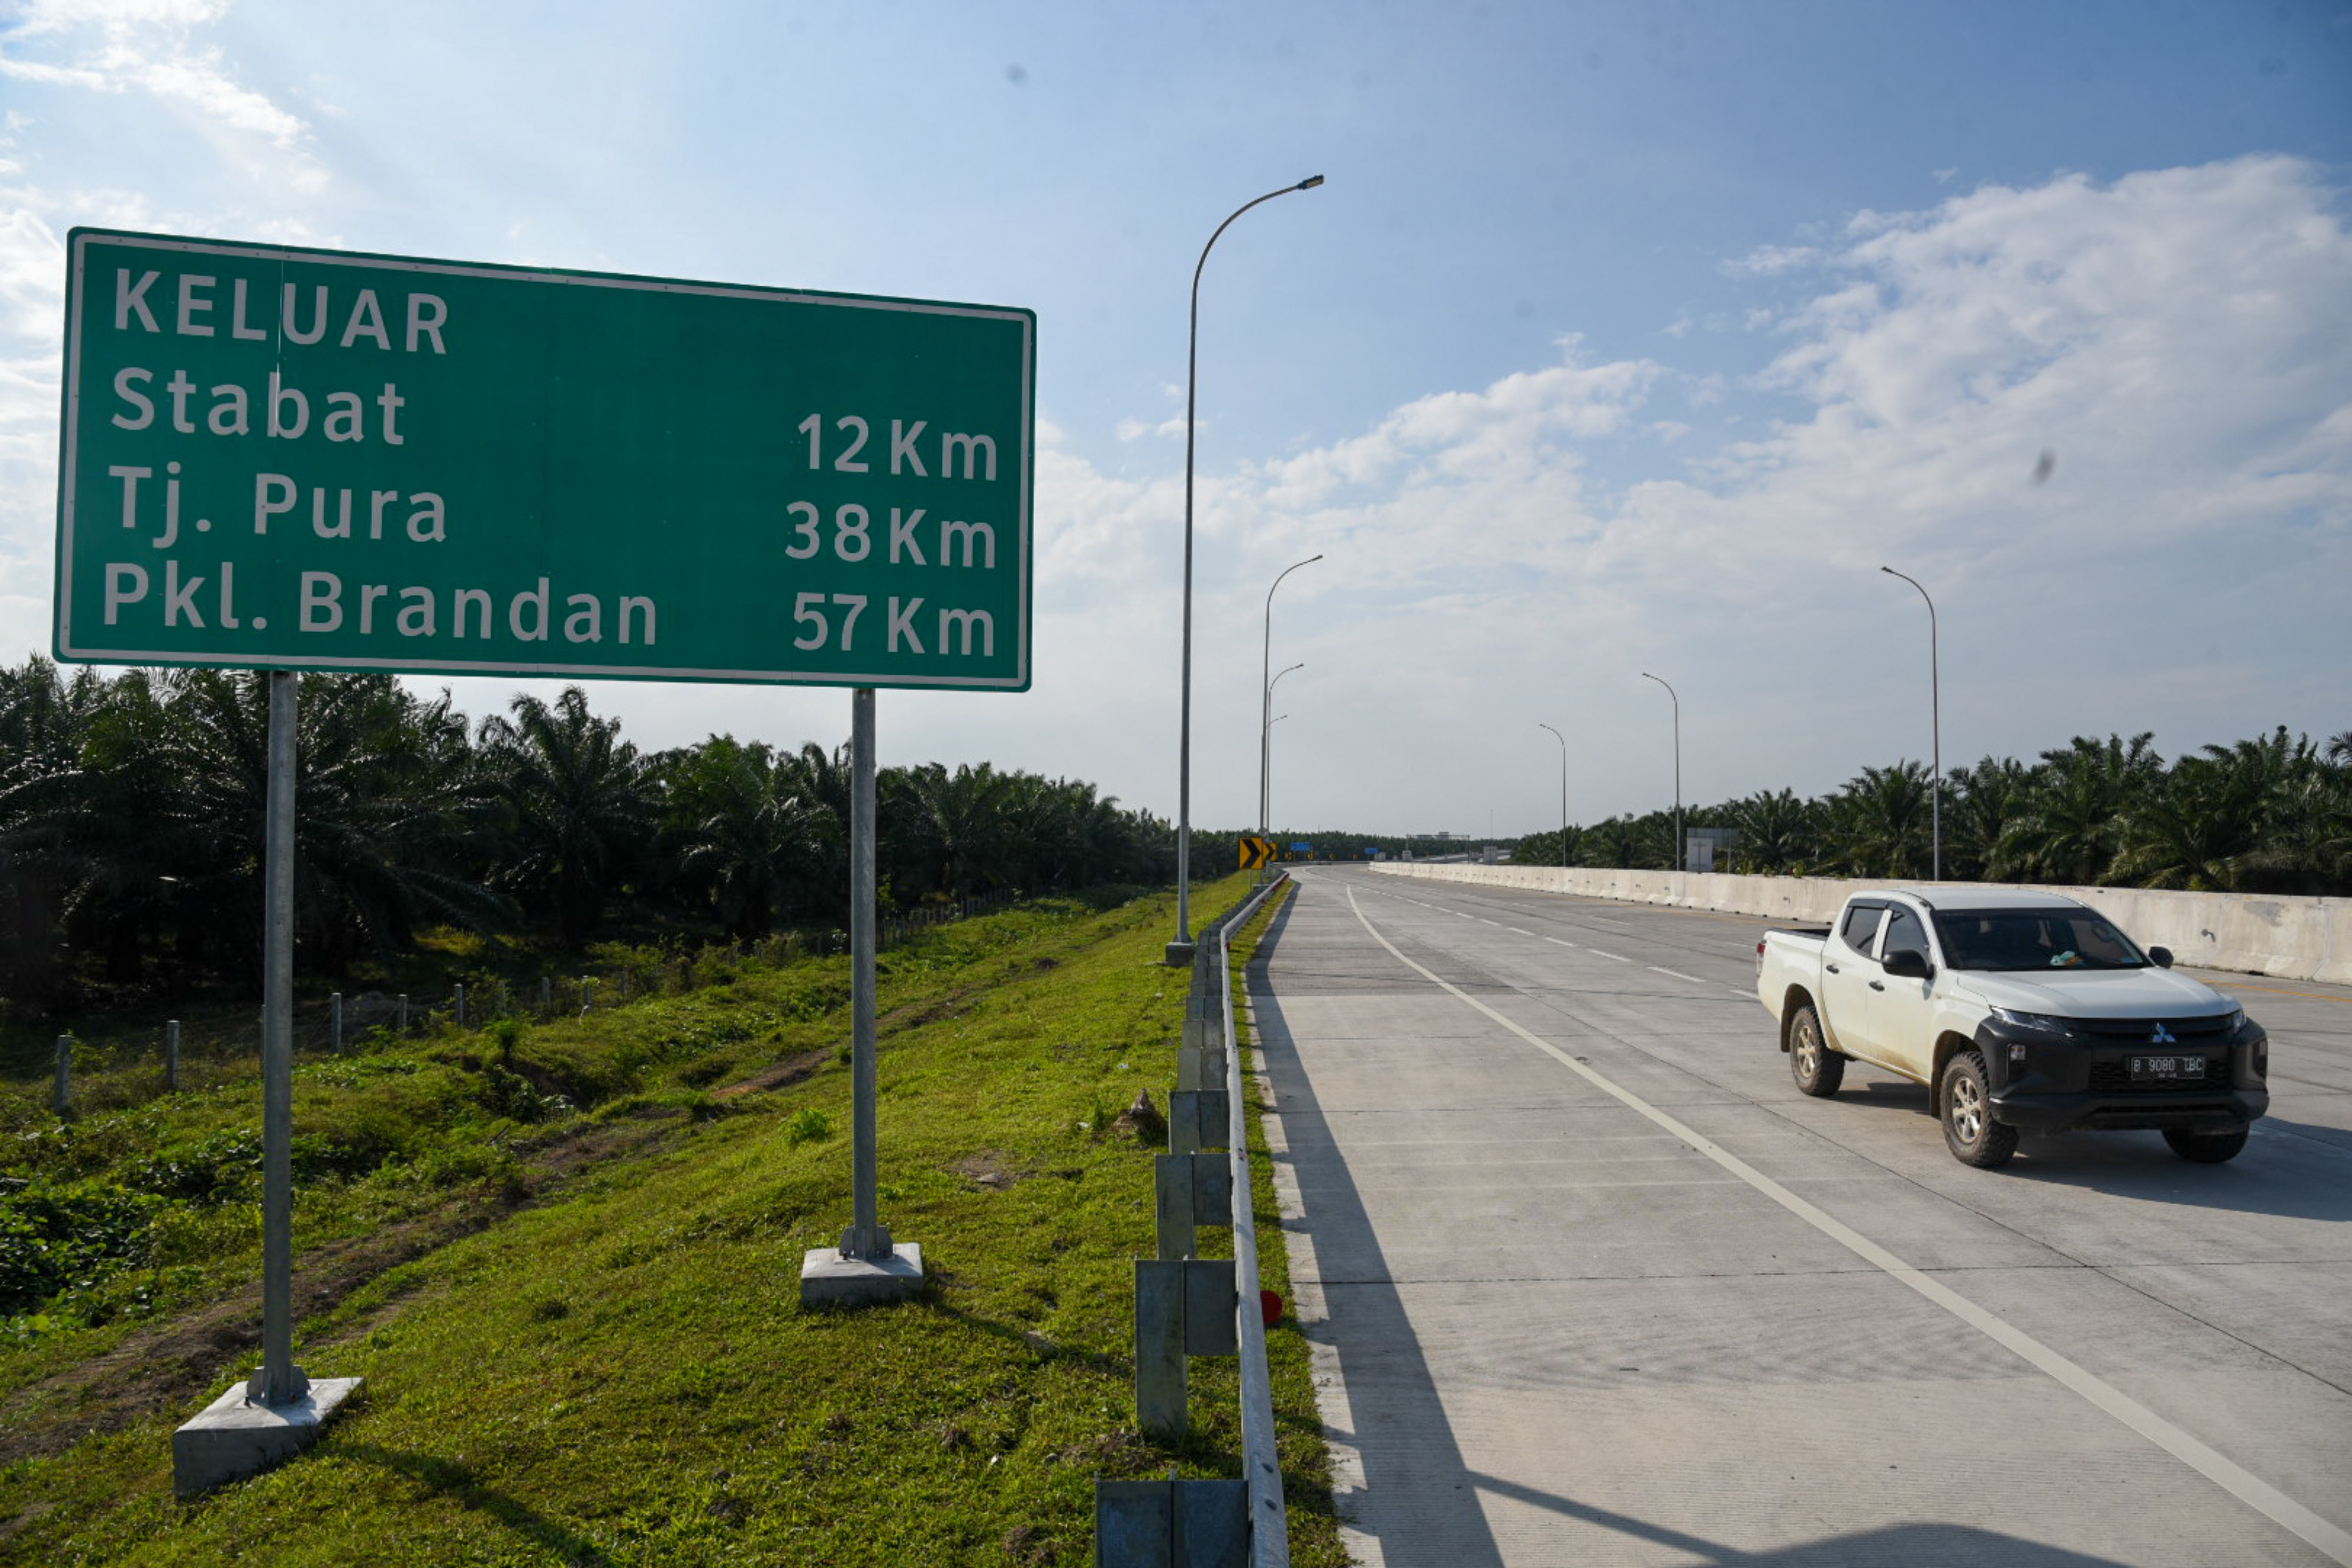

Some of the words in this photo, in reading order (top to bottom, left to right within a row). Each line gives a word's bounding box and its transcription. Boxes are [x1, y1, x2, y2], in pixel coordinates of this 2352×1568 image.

[115, 267, 448, 355] KELUAR
[111, 367, 405, 445] Stabat
[798, 413, 869, 473] 12
[890, 419, 997, 481] Km
[109, 461, 211, 549] Tj.
[254, 473, 446, 542] Pura
[785, 500, 870, 561] 38
[889, 507, 995, 569] Km
[104, 560, 267, 630] Pkl.
[299, 571, 656, 646] Brandan
[793, 591, 868, 651] 57
[887, 596, 994, 657] Km
[2134, 1059, 2141, 1072] B
